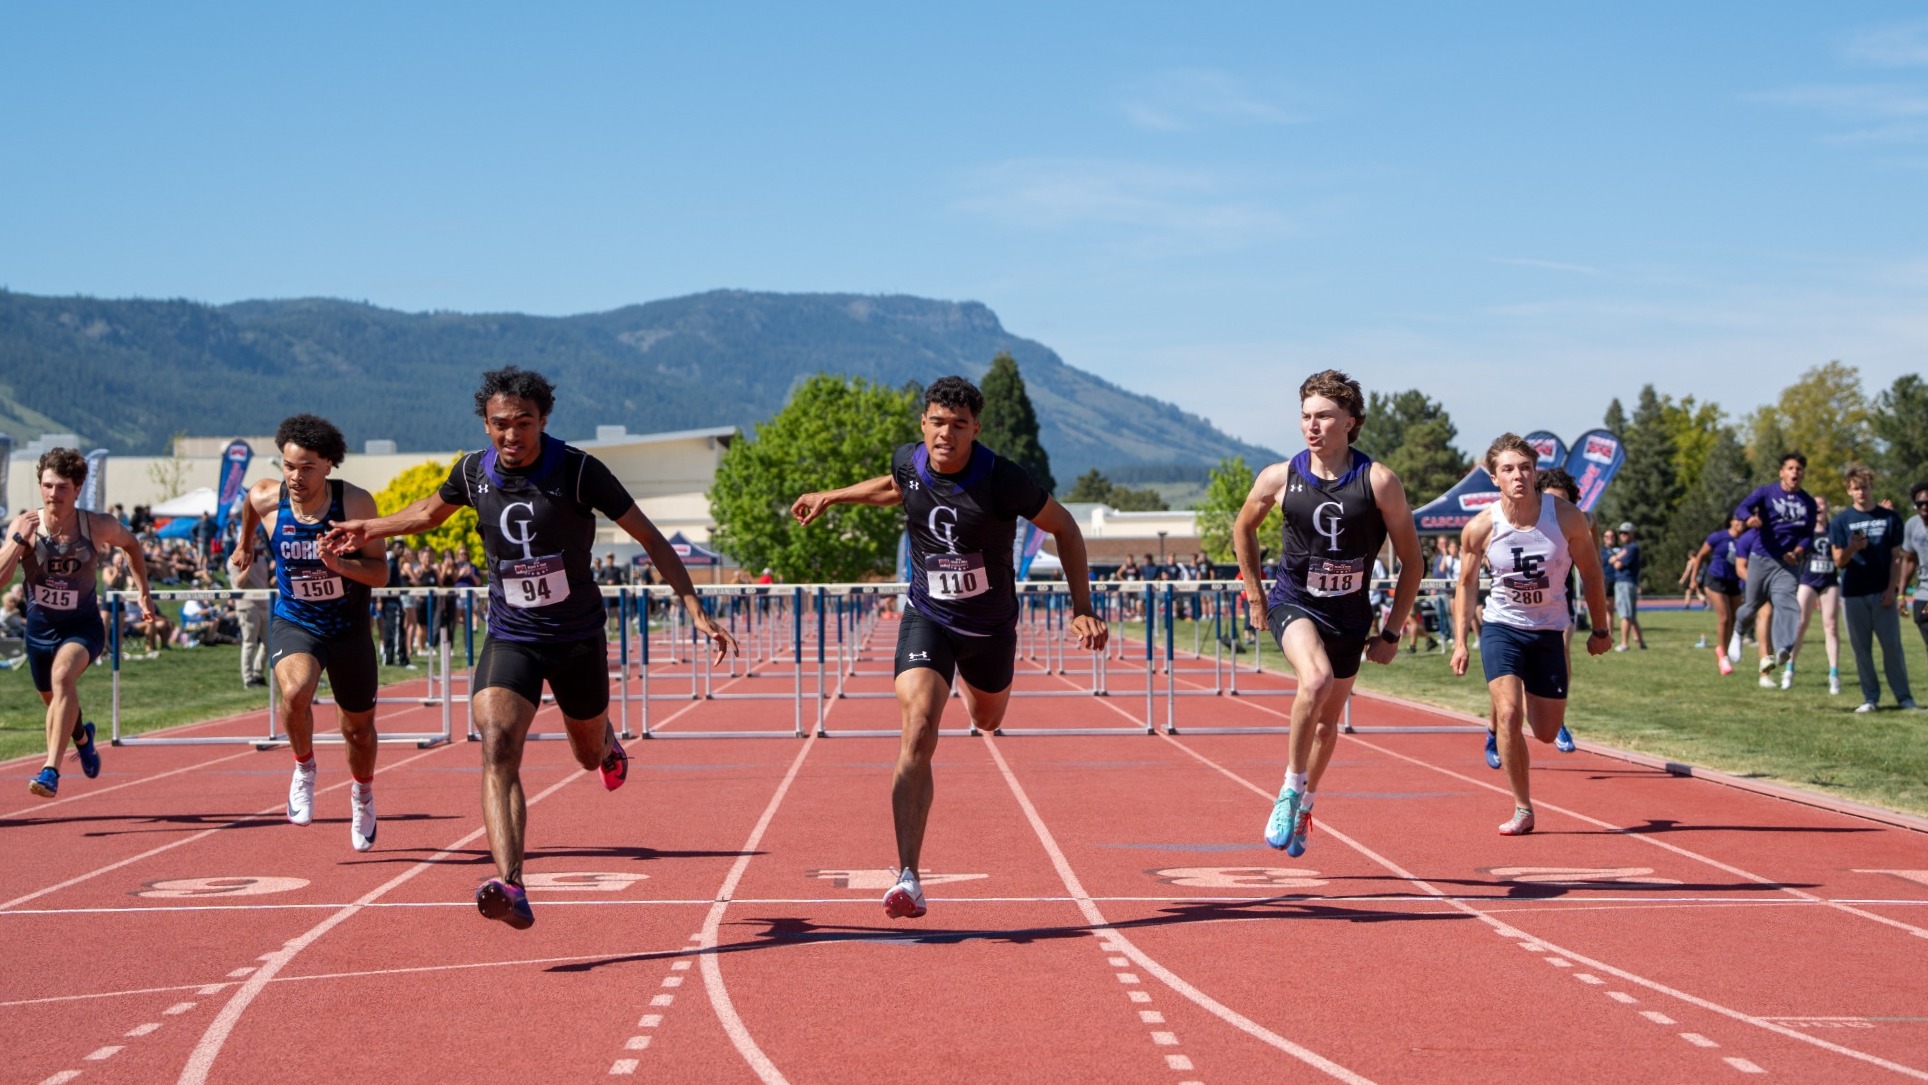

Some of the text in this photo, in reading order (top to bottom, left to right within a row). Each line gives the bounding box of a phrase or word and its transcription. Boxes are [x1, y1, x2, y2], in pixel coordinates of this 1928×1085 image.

[1421, 516, 1474, 528] CASCAD
[280, 541, 321, 560] CORB
[301, 580, 334, 597] 150
[522, 577, 552, 602] 94
[939, 573, 977, 594] 110
[1318, 575, 1353, 592] 118
[41, 589, 71, 606] 215
[1512, 590, 1543, 604] 280
